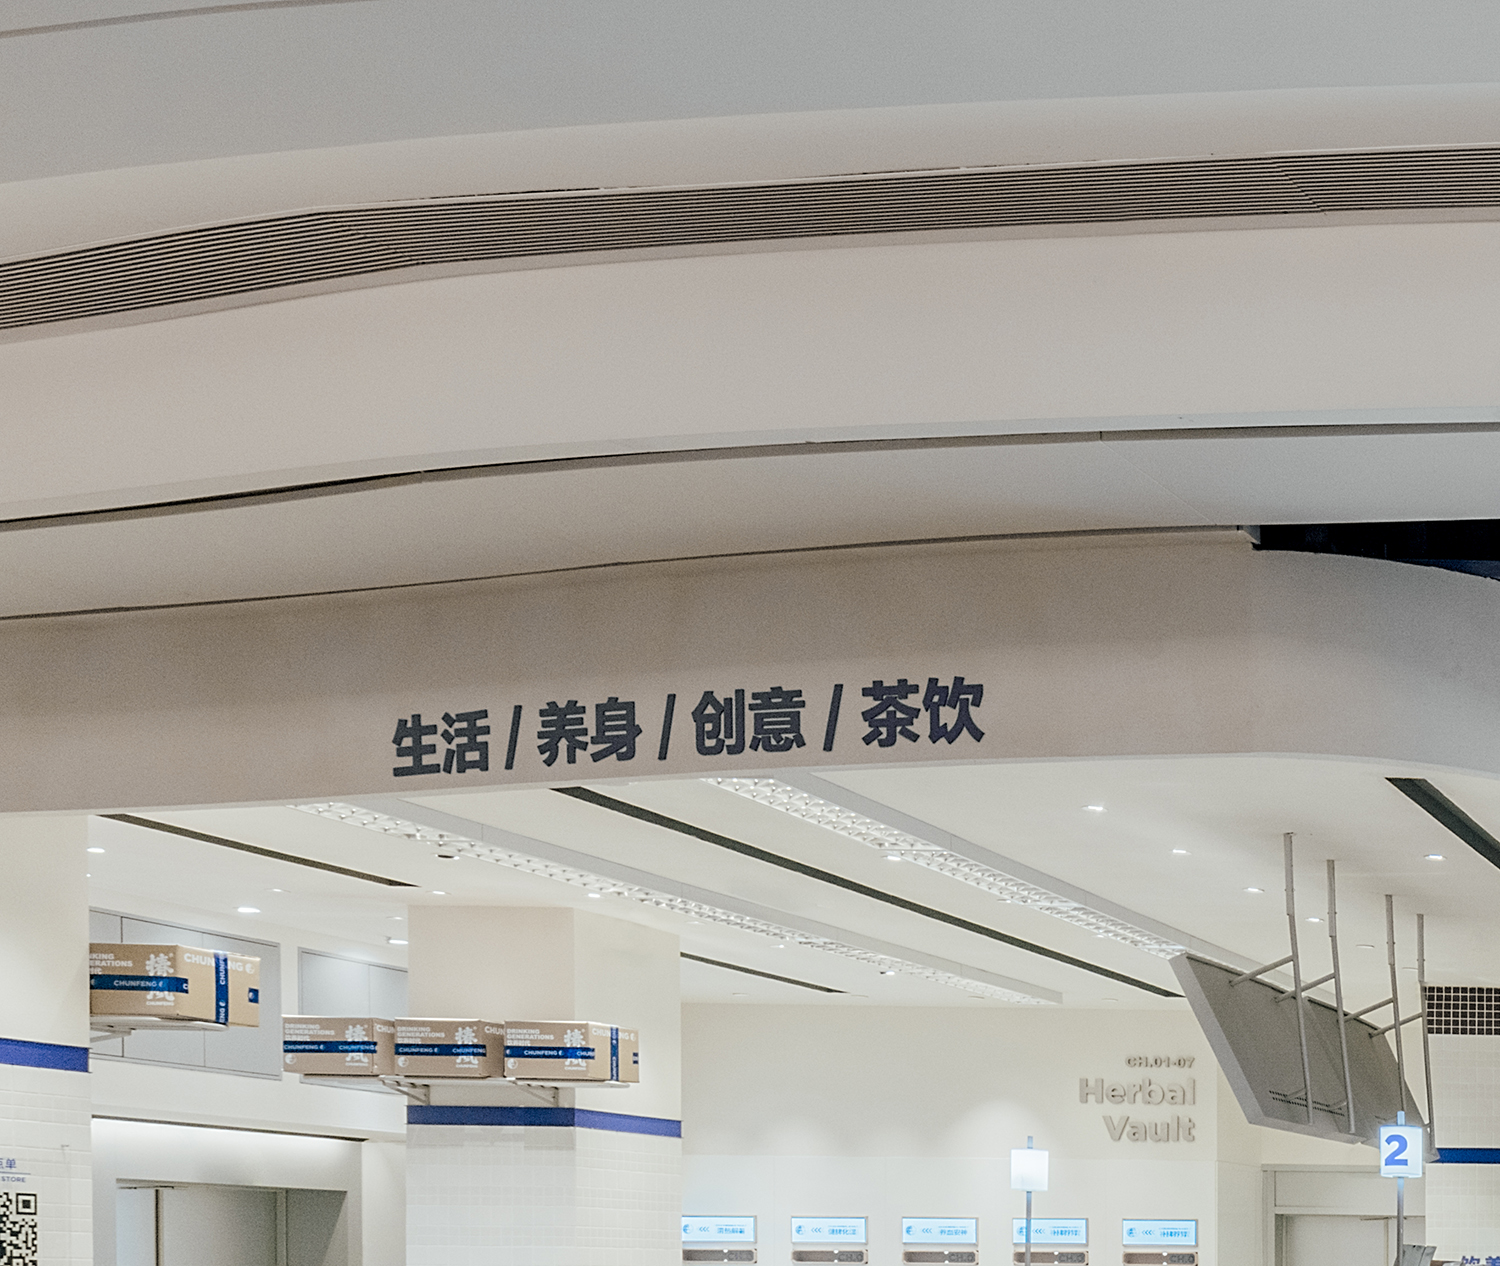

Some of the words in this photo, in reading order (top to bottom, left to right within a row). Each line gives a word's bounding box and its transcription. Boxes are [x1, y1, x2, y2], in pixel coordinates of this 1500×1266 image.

[392, 710, 490, 777] 生活
[505, 704, 522, 770] /
[537, 696, 643, 767] 养身
[658, 693, 676, 760] /
[691, 686, 806, 756] 创意
[824, 684, 844, 753] /
[861, 675, 985, 748] 茶饮
[184, 953, 243, 972] CHUNNG
[113, 980, 157, 988] CHUNFENG
[1079, 1077, 1196, 1105] Herbal
[1102, 1115, 1195, 1142] Vault
[1384, 1134, 1408, 1166] 2
